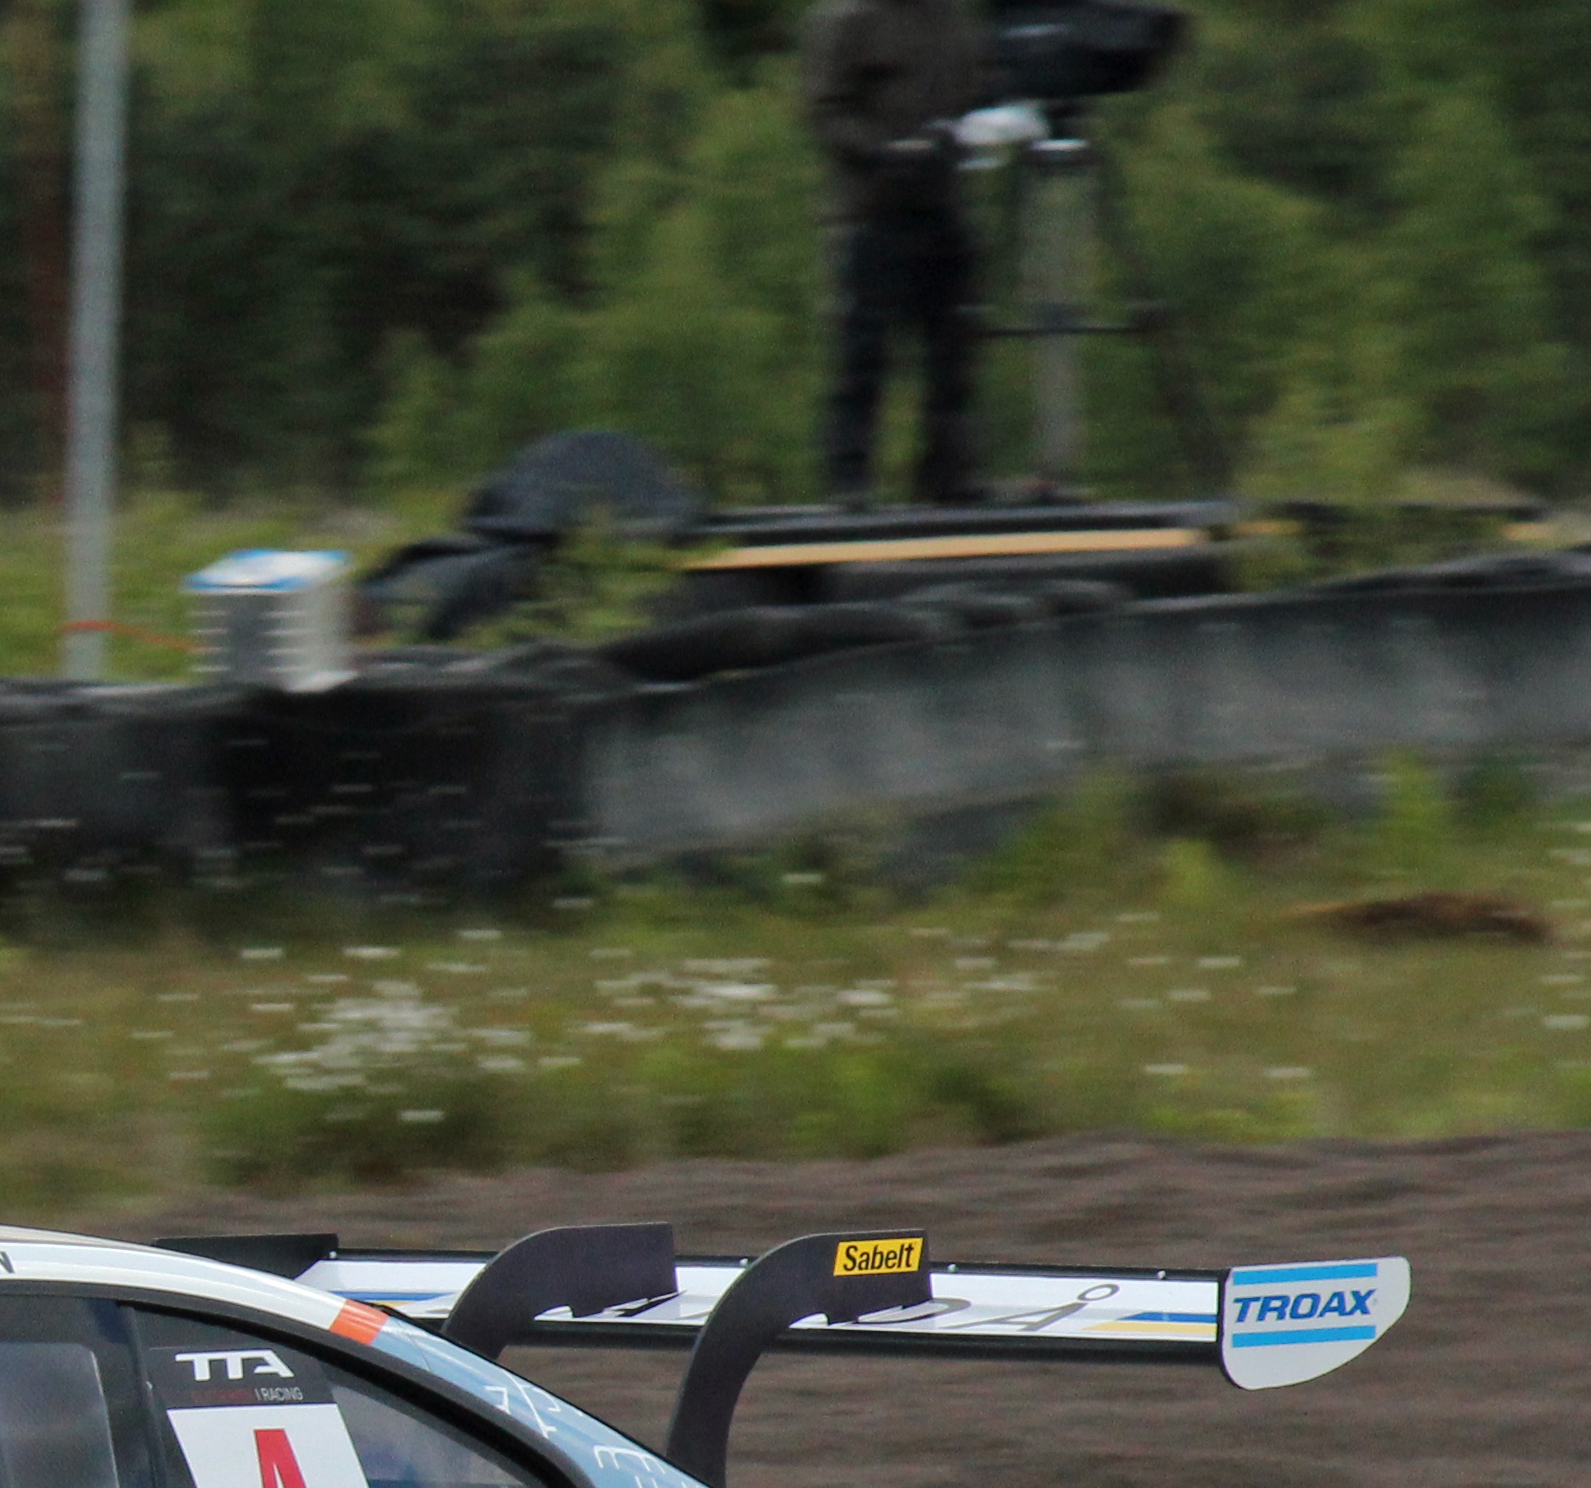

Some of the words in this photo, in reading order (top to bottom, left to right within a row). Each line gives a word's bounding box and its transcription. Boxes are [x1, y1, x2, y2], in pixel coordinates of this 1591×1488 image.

[843, 1242, 915, 1272] Sabelt
[1233, 1289, 1377, 1323] TROAX
[175, 1349, 295, 1381] TTA
